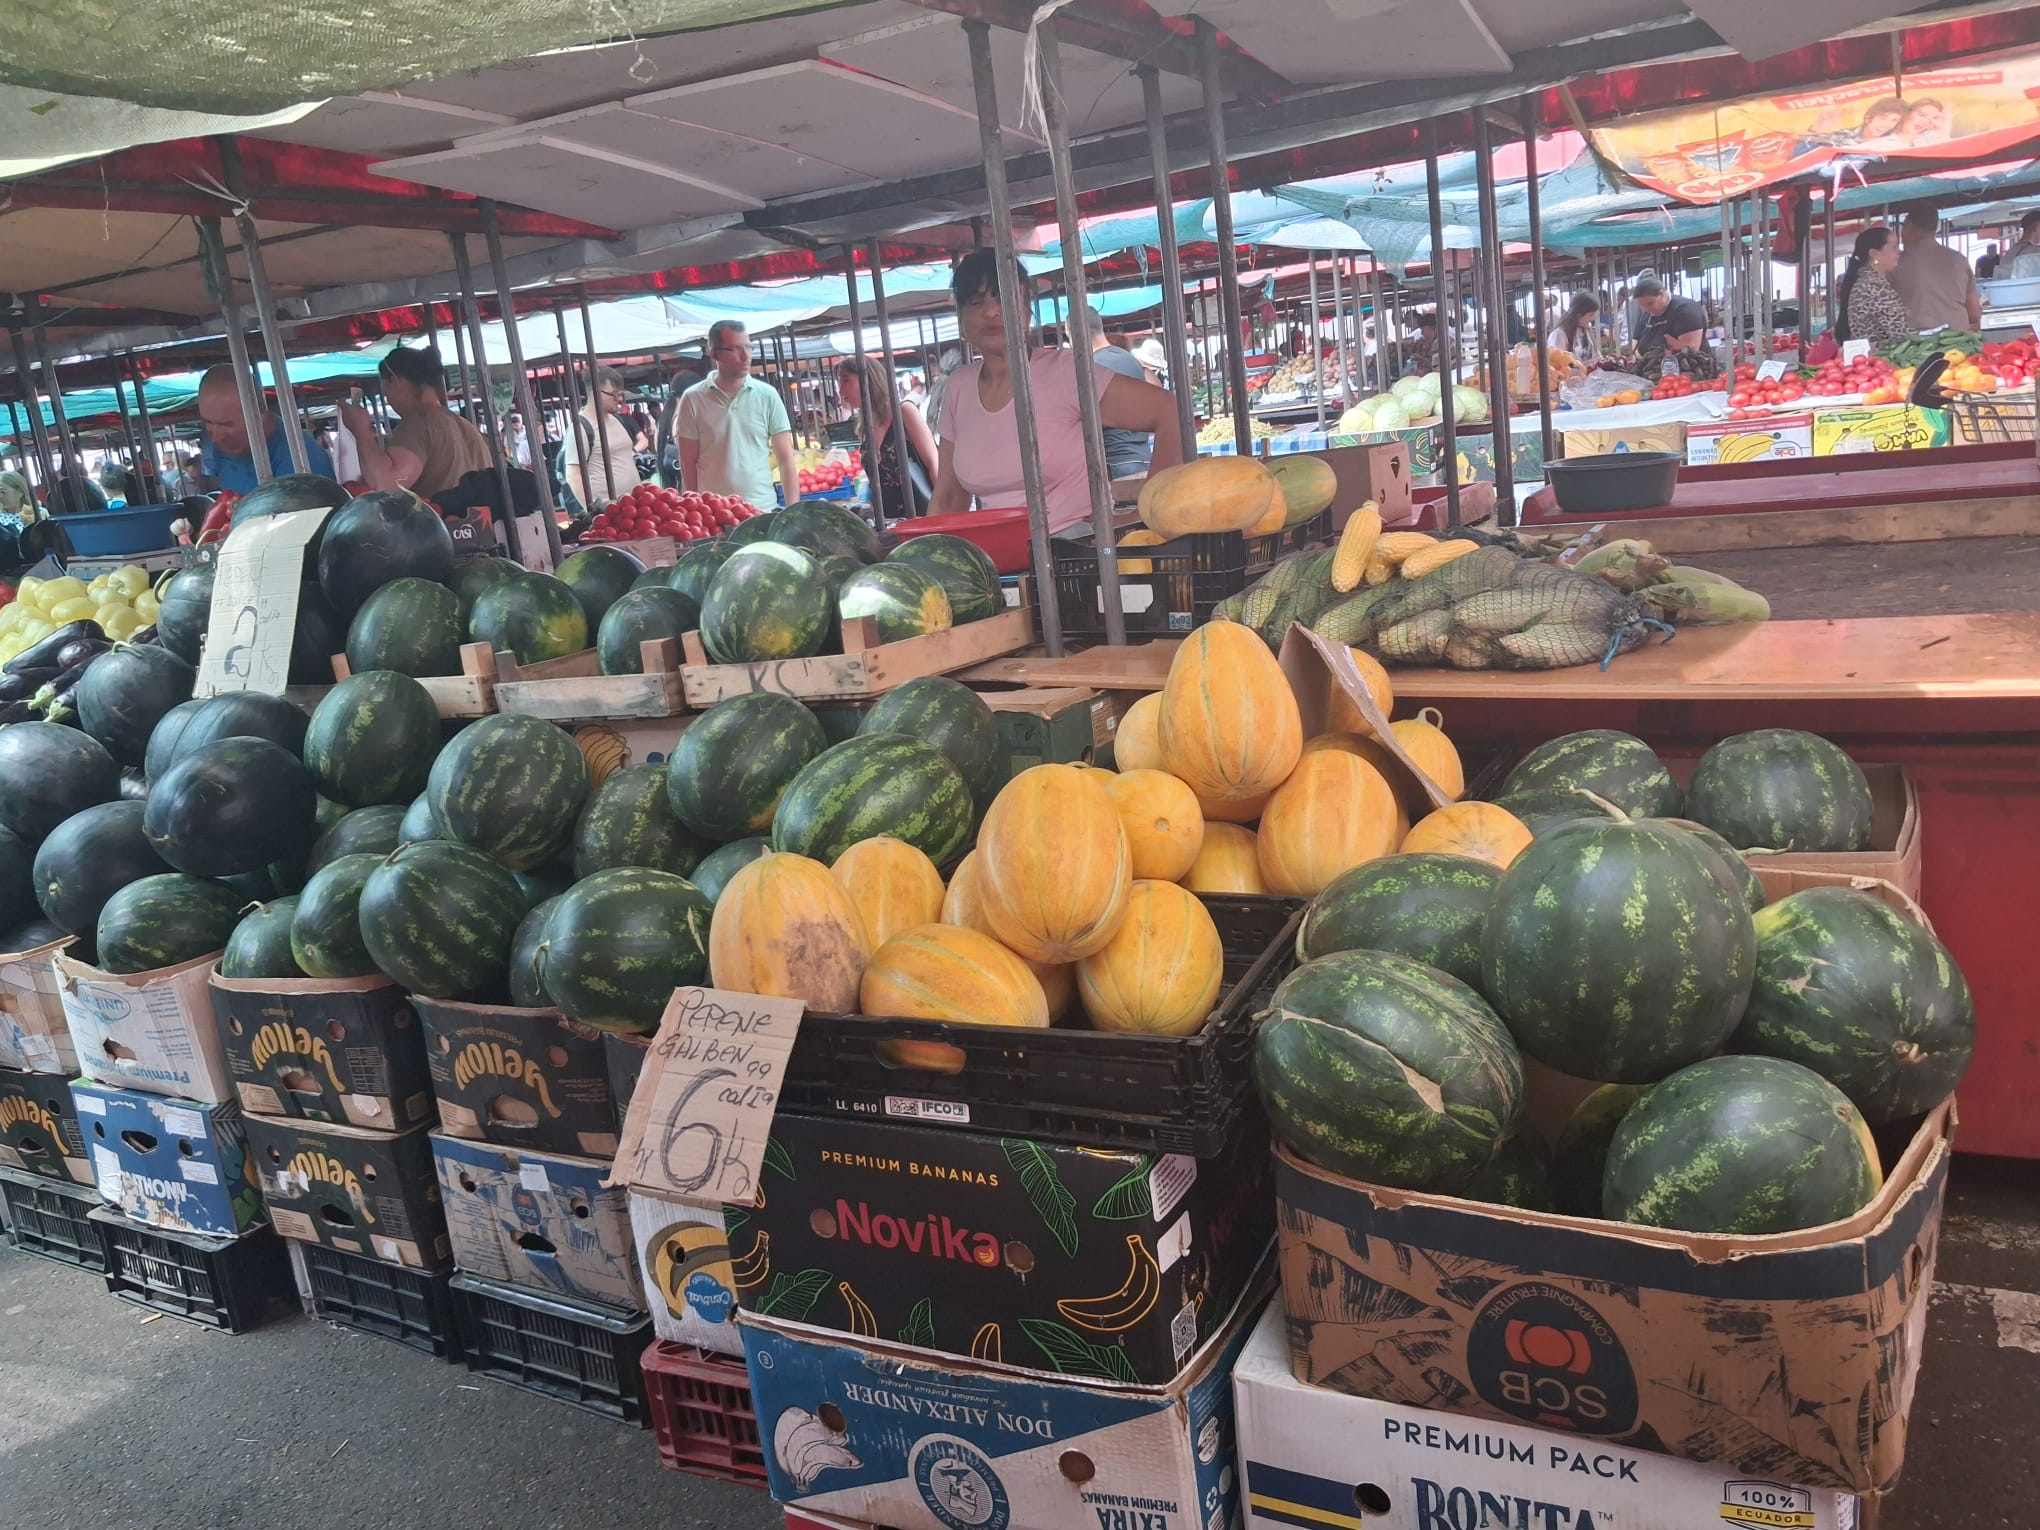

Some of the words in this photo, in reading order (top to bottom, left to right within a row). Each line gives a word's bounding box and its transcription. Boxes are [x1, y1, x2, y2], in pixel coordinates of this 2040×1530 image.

[678, 989, 774, 1036] PEPENE
[252, 1022, 346, 1093] yellow
[656, 1033, 752, 1064] GALBEN
[454, 1041, 562, 1119] yellow
[853, 1102, 878, 1113] 6410
[922, 1101, 952, 1115] IFCO
[660, 1067, 738, 1192] 6
[821, 1149, 901, 1173] PREMIUM
[909, 1162, 999, 1187] BANANAS
[836, 1198, 1000, 1267] Novika
[686, 1291, 731, 1305] Central
[1541, 1285, 1614, 1345] COMPAGNIE
[844, 1380, 990, 1426] ALEXANDER
[1498, 1370, 1608, 1419] SCB
[996, 1411, 1055, 1439] DON
[1384, 1418, 1535, 1466] PREMIUM
[1550, 1446, 1640, 1483] PACK
[1080, 1491, 1129, 1507] BANANAS
[1130, 1497, 1178, 1513] PREMIUM
[1736, 1508, 1802, 1523] ECUADOR
[1741, 1490, 1795, 1508] 100%
[1095, 1507, 1167, 1530] EXTRA
